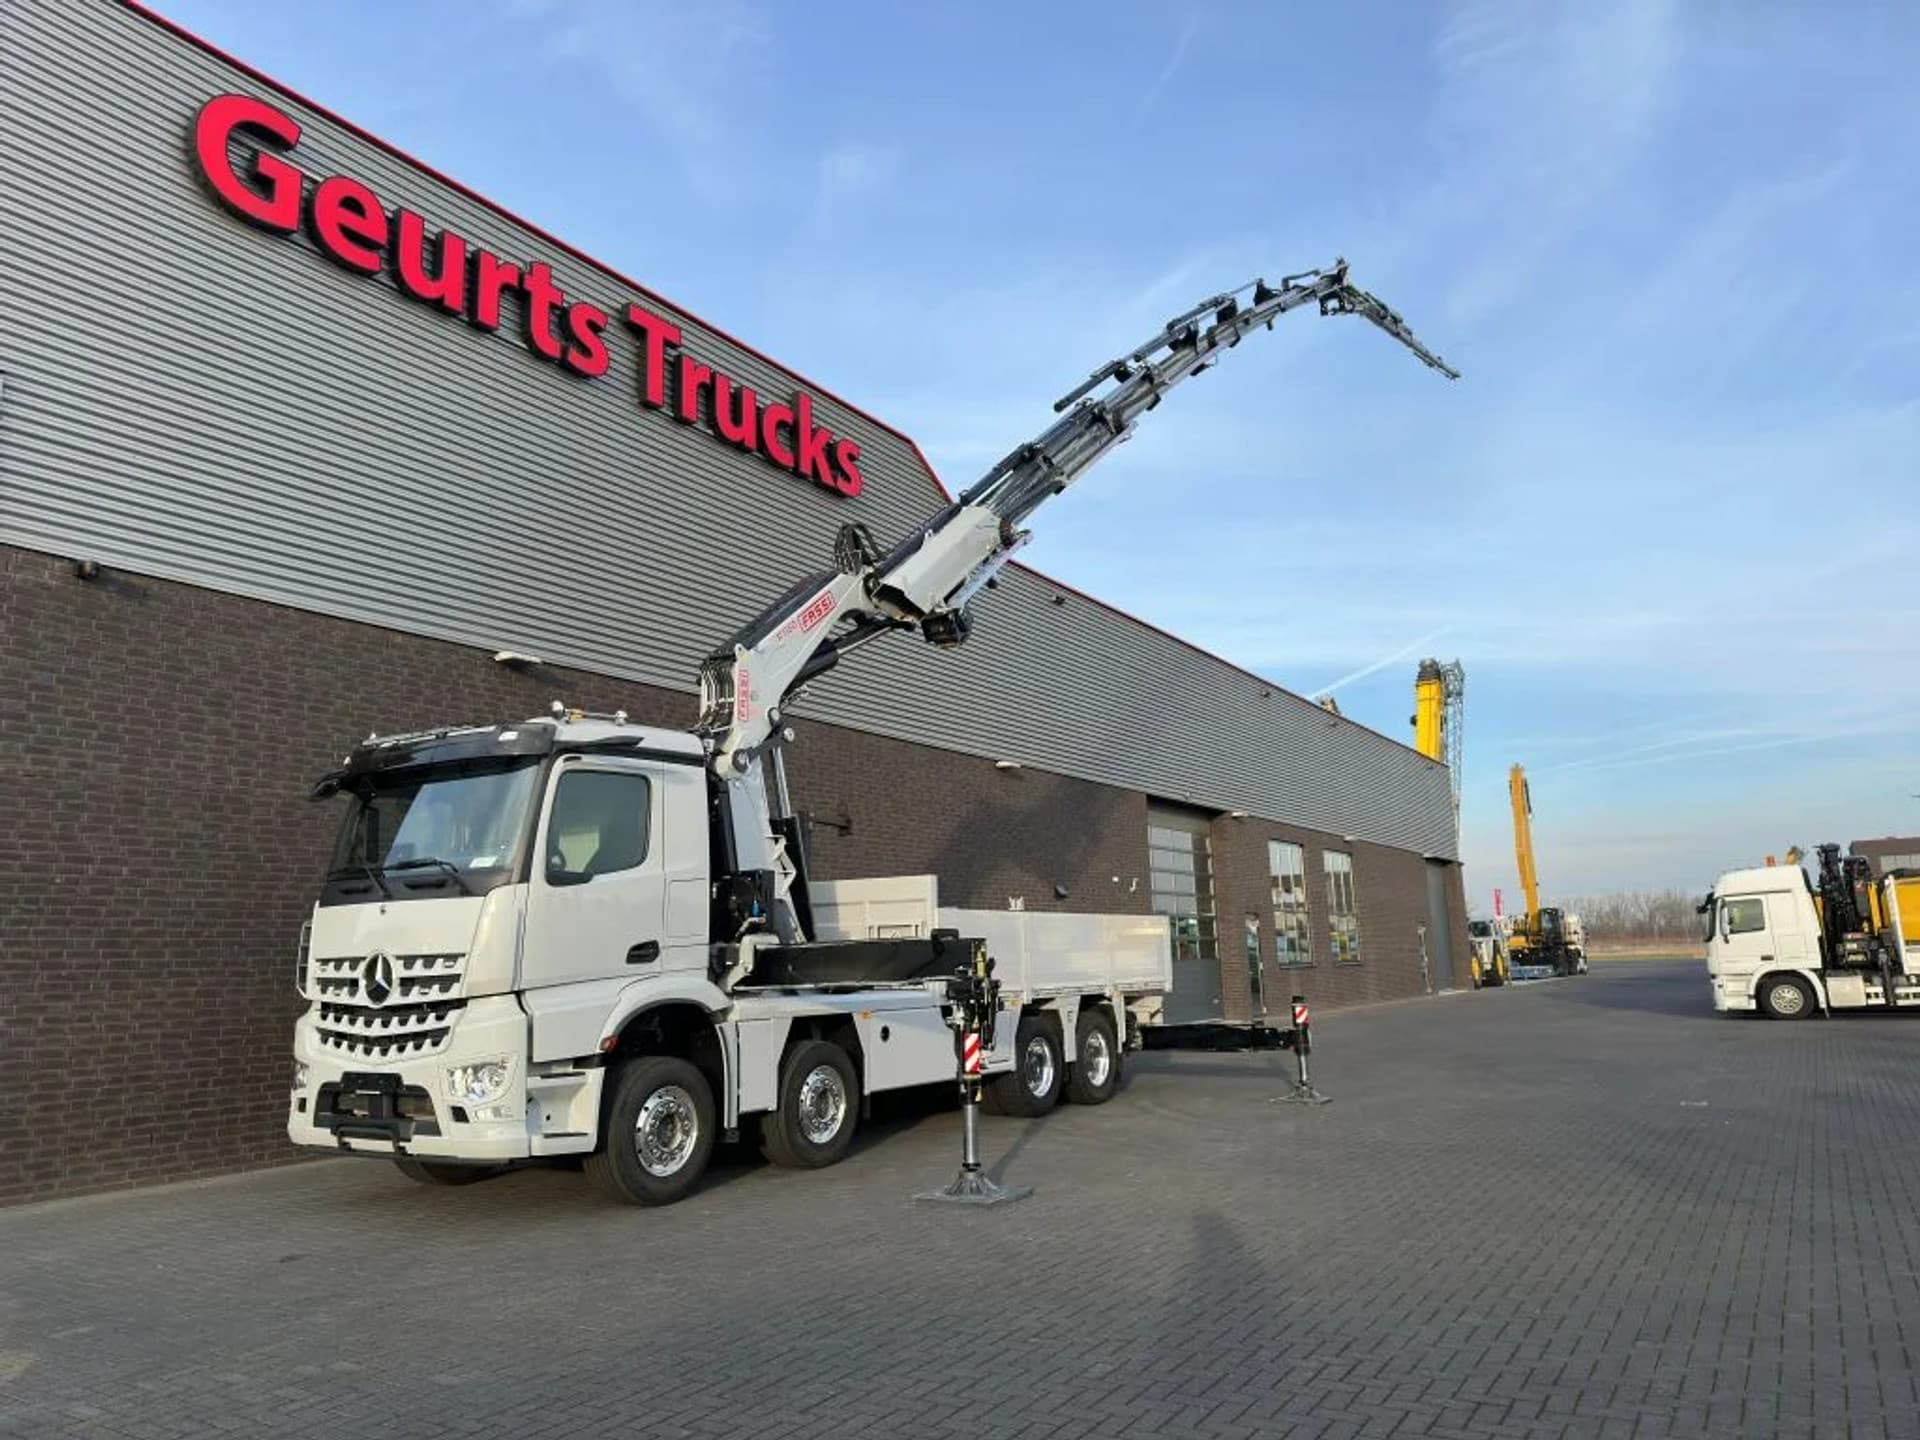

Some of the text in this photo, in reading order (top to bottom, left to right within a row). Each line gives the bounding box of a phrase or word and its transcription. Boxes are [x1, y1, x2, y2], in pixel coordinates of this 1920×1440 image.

[193, 93, 863, 498] Geurts Trucks
[801, 595, 833, 629] FASSI
